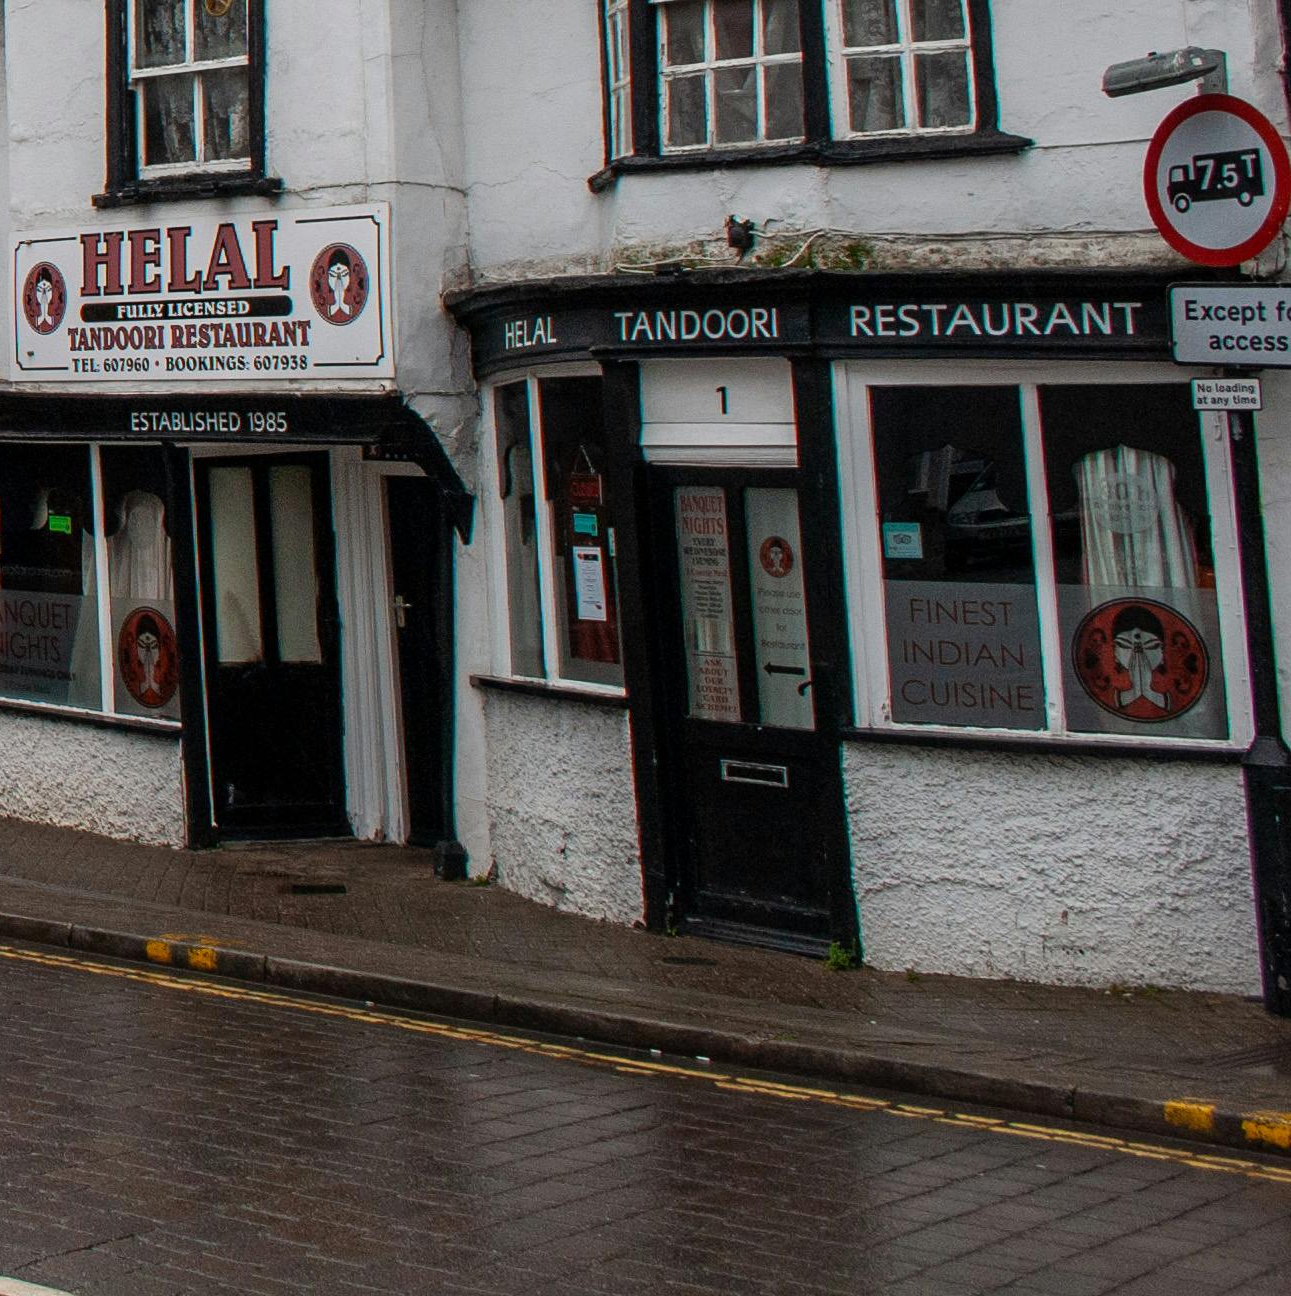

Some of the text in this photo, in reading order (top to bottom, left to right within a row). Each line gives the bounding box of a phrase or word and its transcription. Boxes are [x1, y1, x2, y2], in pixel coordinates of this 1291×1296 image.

[79, 218, 291, 297] HELAL
[117, 300, 250, 320] FULLY LICENSED
[1184, 300, 1267, 326] Except
[67, 319, 312, 352] TANDOORI RESTAURANT
[504, 302, 1142, 350] HELAL TANDOORI RESTAURANT
[1208, 333, 1289, 352] access
[71, 355, 308, 373] TEL: 607960 BOOKINGS: 607938
[715, 385, 728, 415] 1
[1196, 394, 1257, 406] at any time
[1197, 383, 1255, 394] No loading
[130, 410, 288, 433] ESTABLISHED 1985
[682, 517, 725, 535] NIGHTS
[910, 598, 1012, 627] FINEST
[903, 639, 1024, 669] INDIAN
[901, 679, 1035, 712] CUISINE
